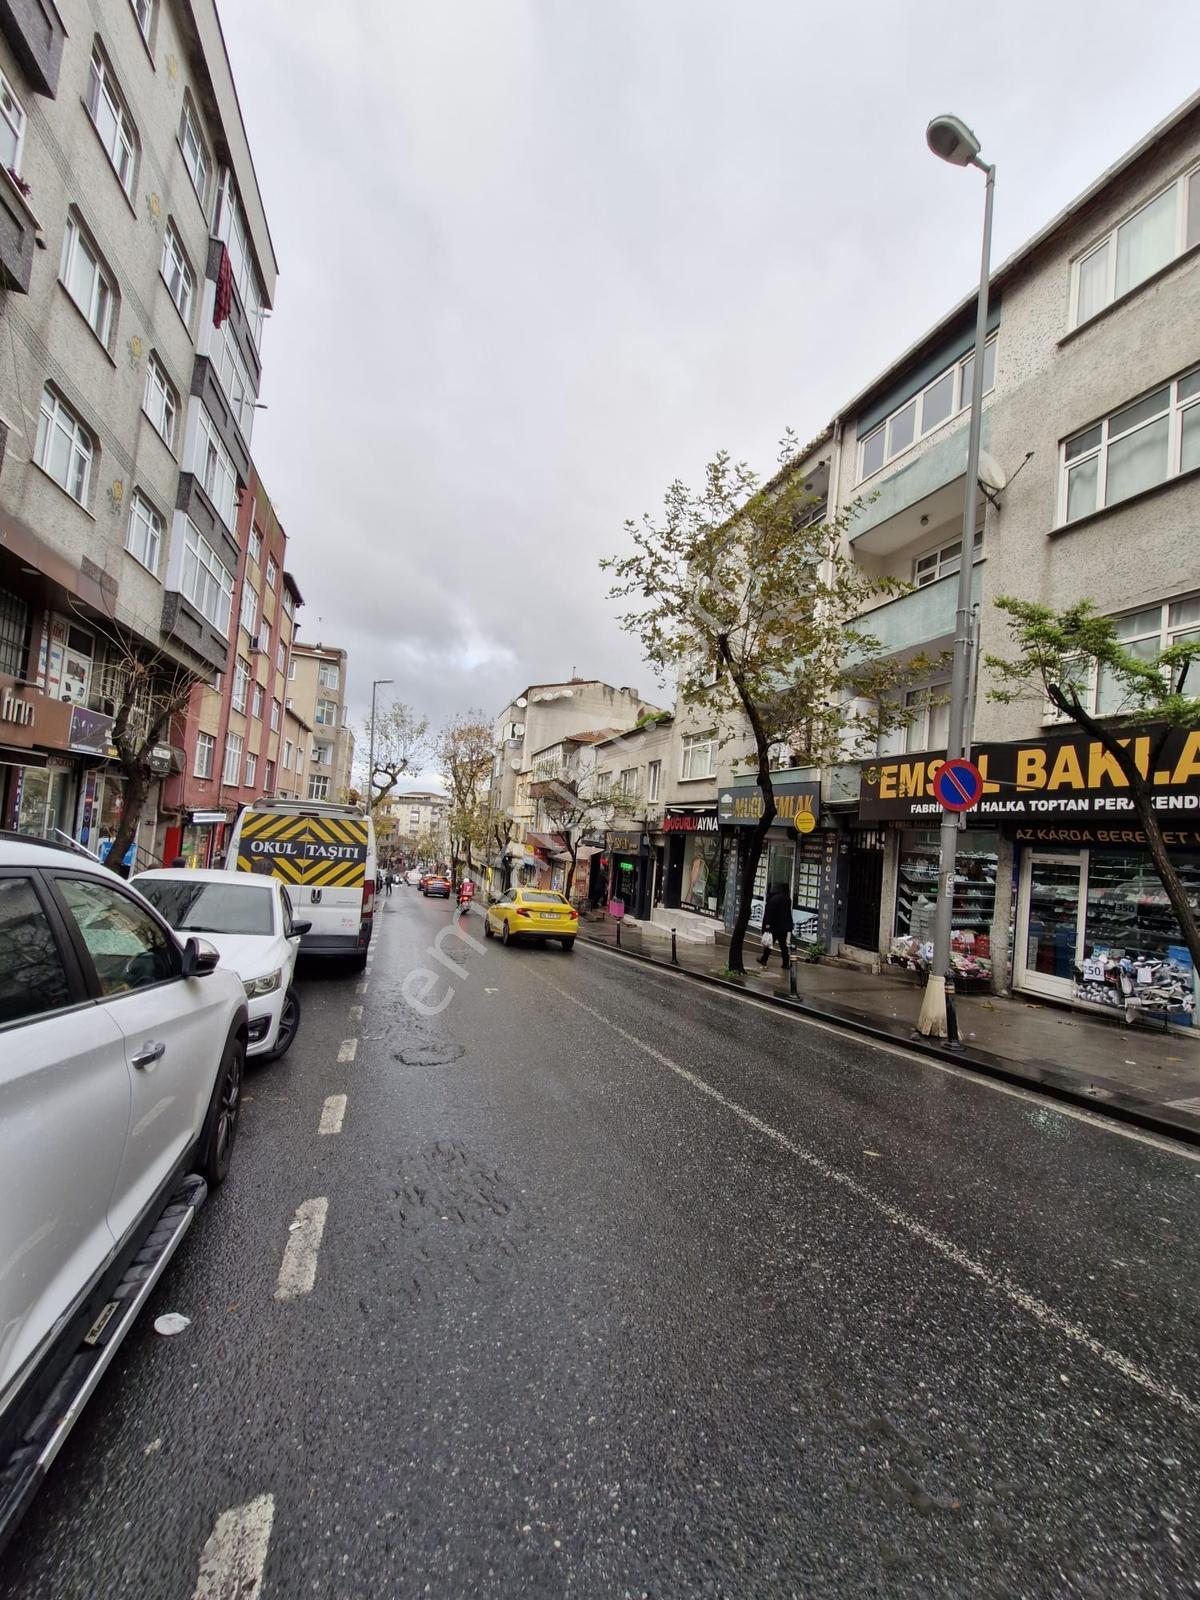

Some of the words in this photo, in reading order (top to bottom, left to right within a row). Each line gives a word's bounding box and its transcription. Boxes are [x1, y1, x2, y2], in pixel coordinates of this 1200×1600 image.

[879, 755, 1000, 799] EMSL
[735, 790, 764, 818] MUĞL
[911, 801, 978, 813] FABRİN
[981, 800, 1026, 812] HALKA
[1029, 799, 1089, 811] TOPTAN
[1094, 795, 1200, 811] PEREND
[1016, 829, 1036, 840] AZ
[1097, 830, 1188, 844] BEREET
[250, 840, 297, 855] OKUL
[307, 844, 359, 860] TAŞITI
